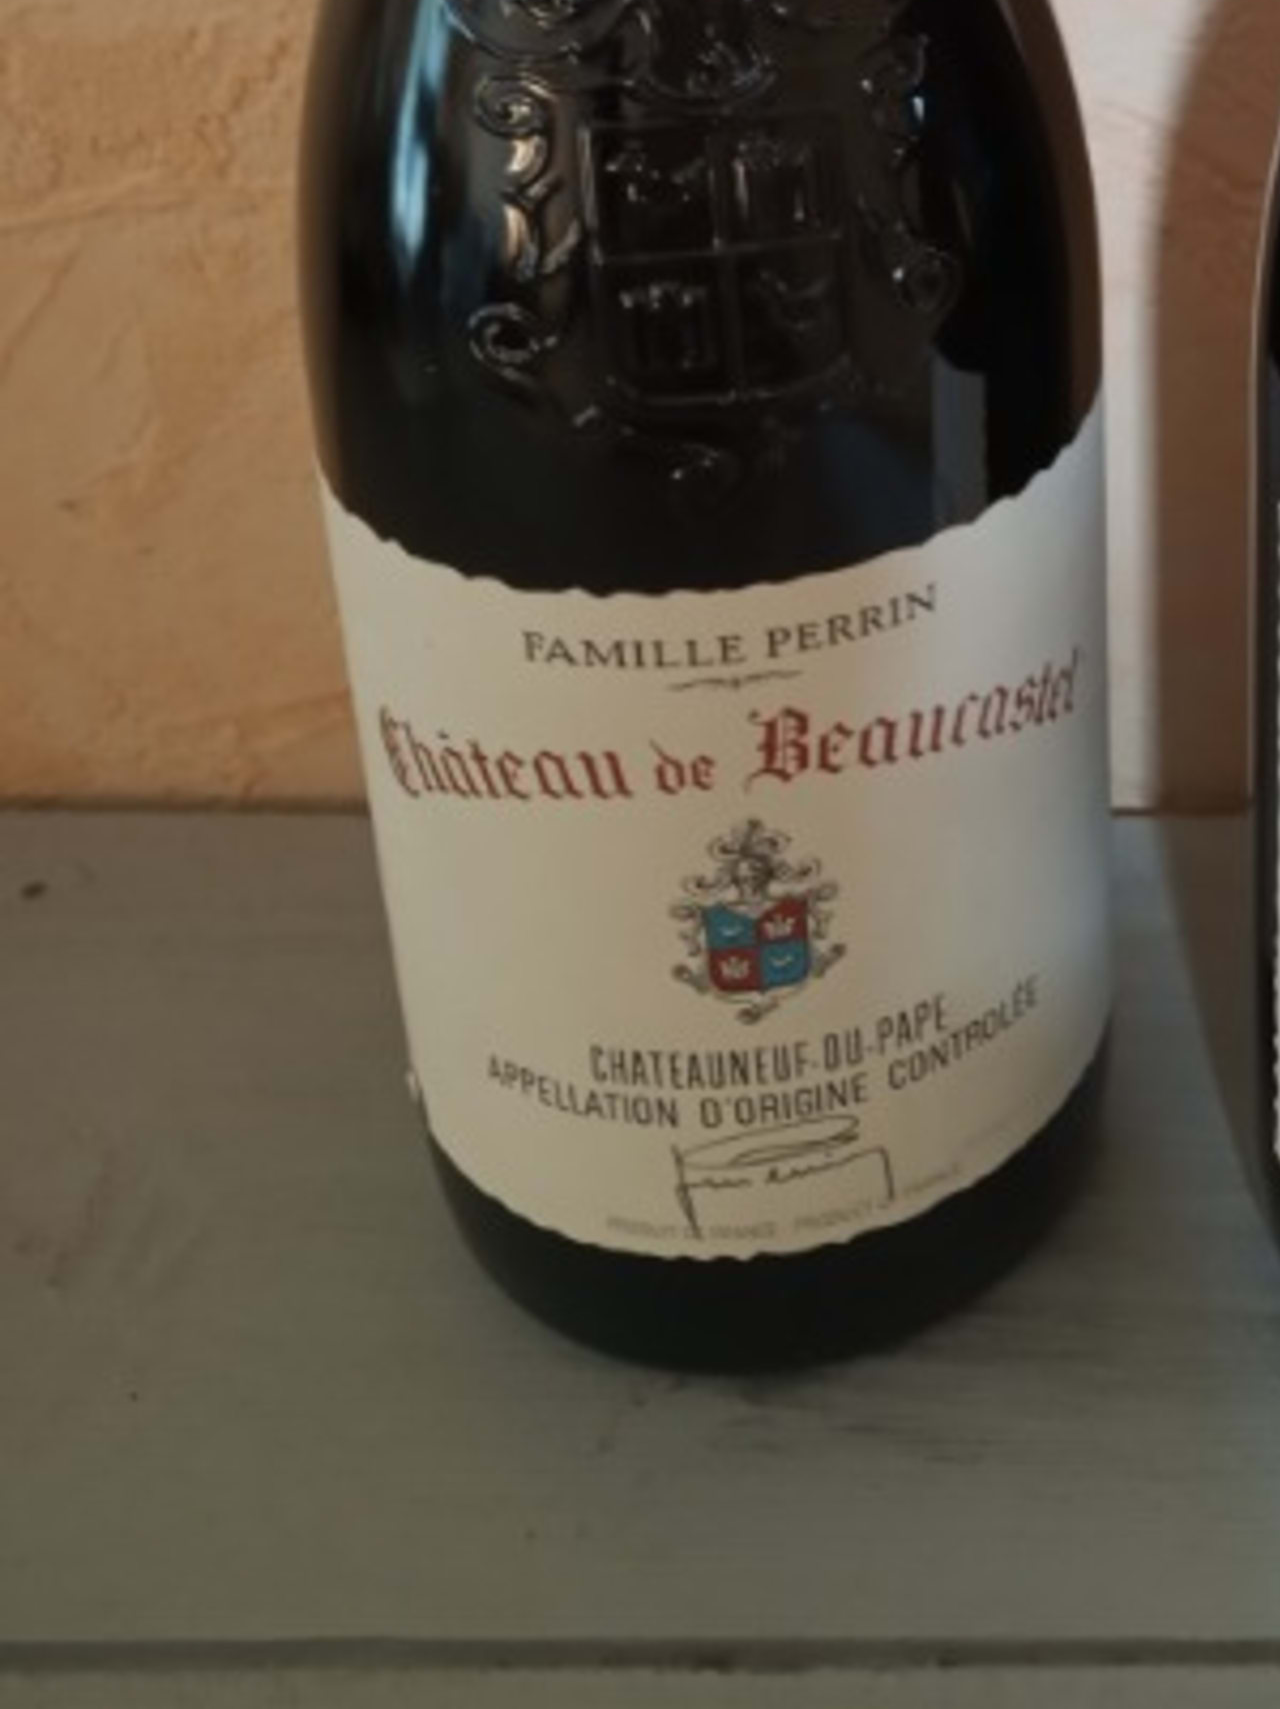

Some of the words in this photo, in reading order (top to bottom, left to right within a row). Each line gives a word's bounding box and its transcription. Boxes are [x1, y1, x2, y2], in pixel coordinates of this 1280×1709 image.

[522, 630, 747, 670] FAMILLE
[765, 583, 938, 661] PERRIN
[378, 703, 634, 802] Château
[649, 738, 716, 793] de
[744, 646, 1088, 793] Beaucastel
[589, 993, 950, 1091] CHATEAUNEUF-DU-PAPE
[487, 1053, 681, 1129] APPELLATION
[701, 1078, 870, 1130] D'ORIGINE
